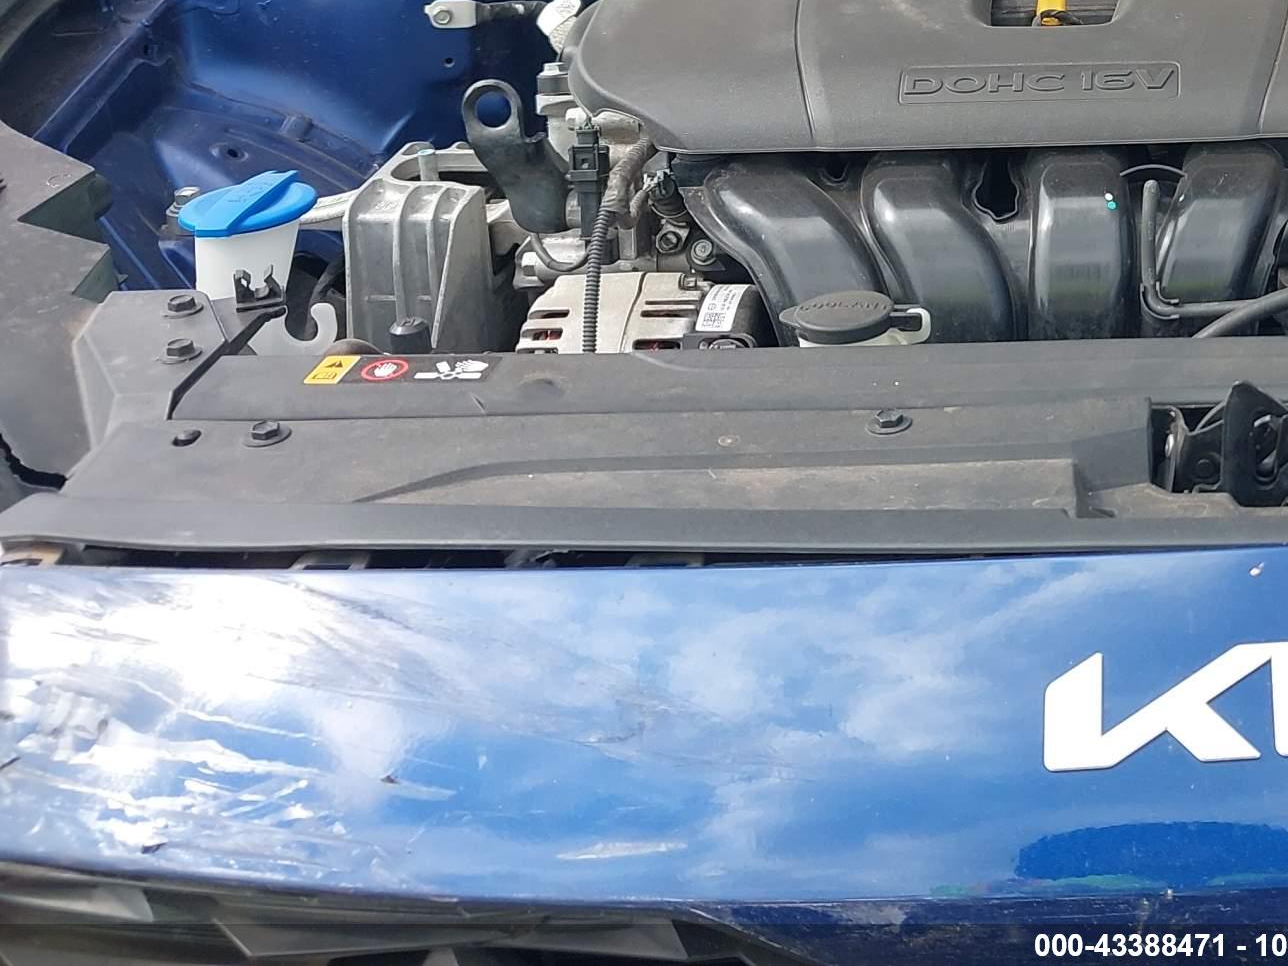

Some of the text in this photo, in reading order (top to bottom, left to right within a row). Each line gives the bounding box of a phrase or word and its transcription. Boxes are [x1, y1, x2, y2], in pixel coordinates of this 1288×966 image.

[902, 68, 1175, 96] DOHC 16V
[798, 300, 891, 312] COOLANT
